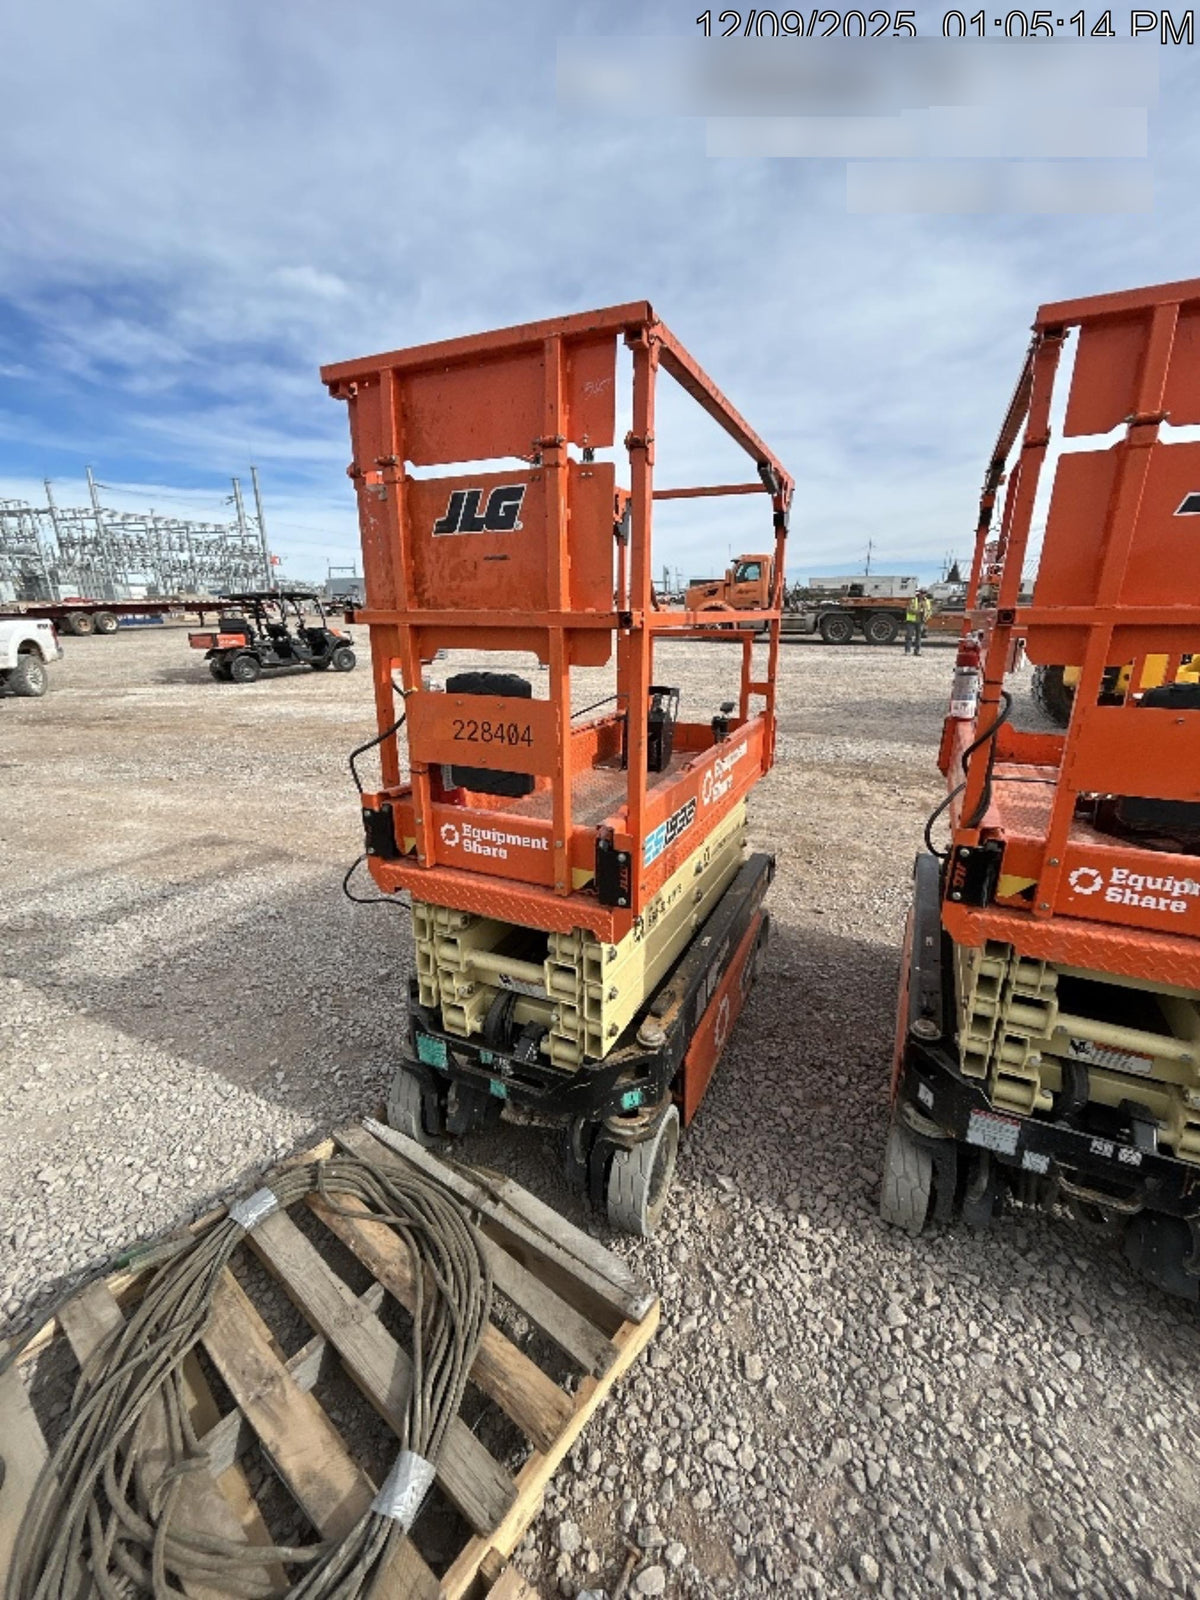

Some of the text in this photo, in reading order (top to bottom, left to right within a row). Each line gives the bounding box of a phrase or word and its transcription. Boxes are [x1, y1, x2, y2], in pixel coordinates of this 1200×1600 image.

[431, 483, 527, 537] JLG
[452, 719, 533, 747] 228404
[462, 822, 549, 850] Equipment
[463, 838, 508, 859] Share
[1104, 886, 1187, 913] Share
